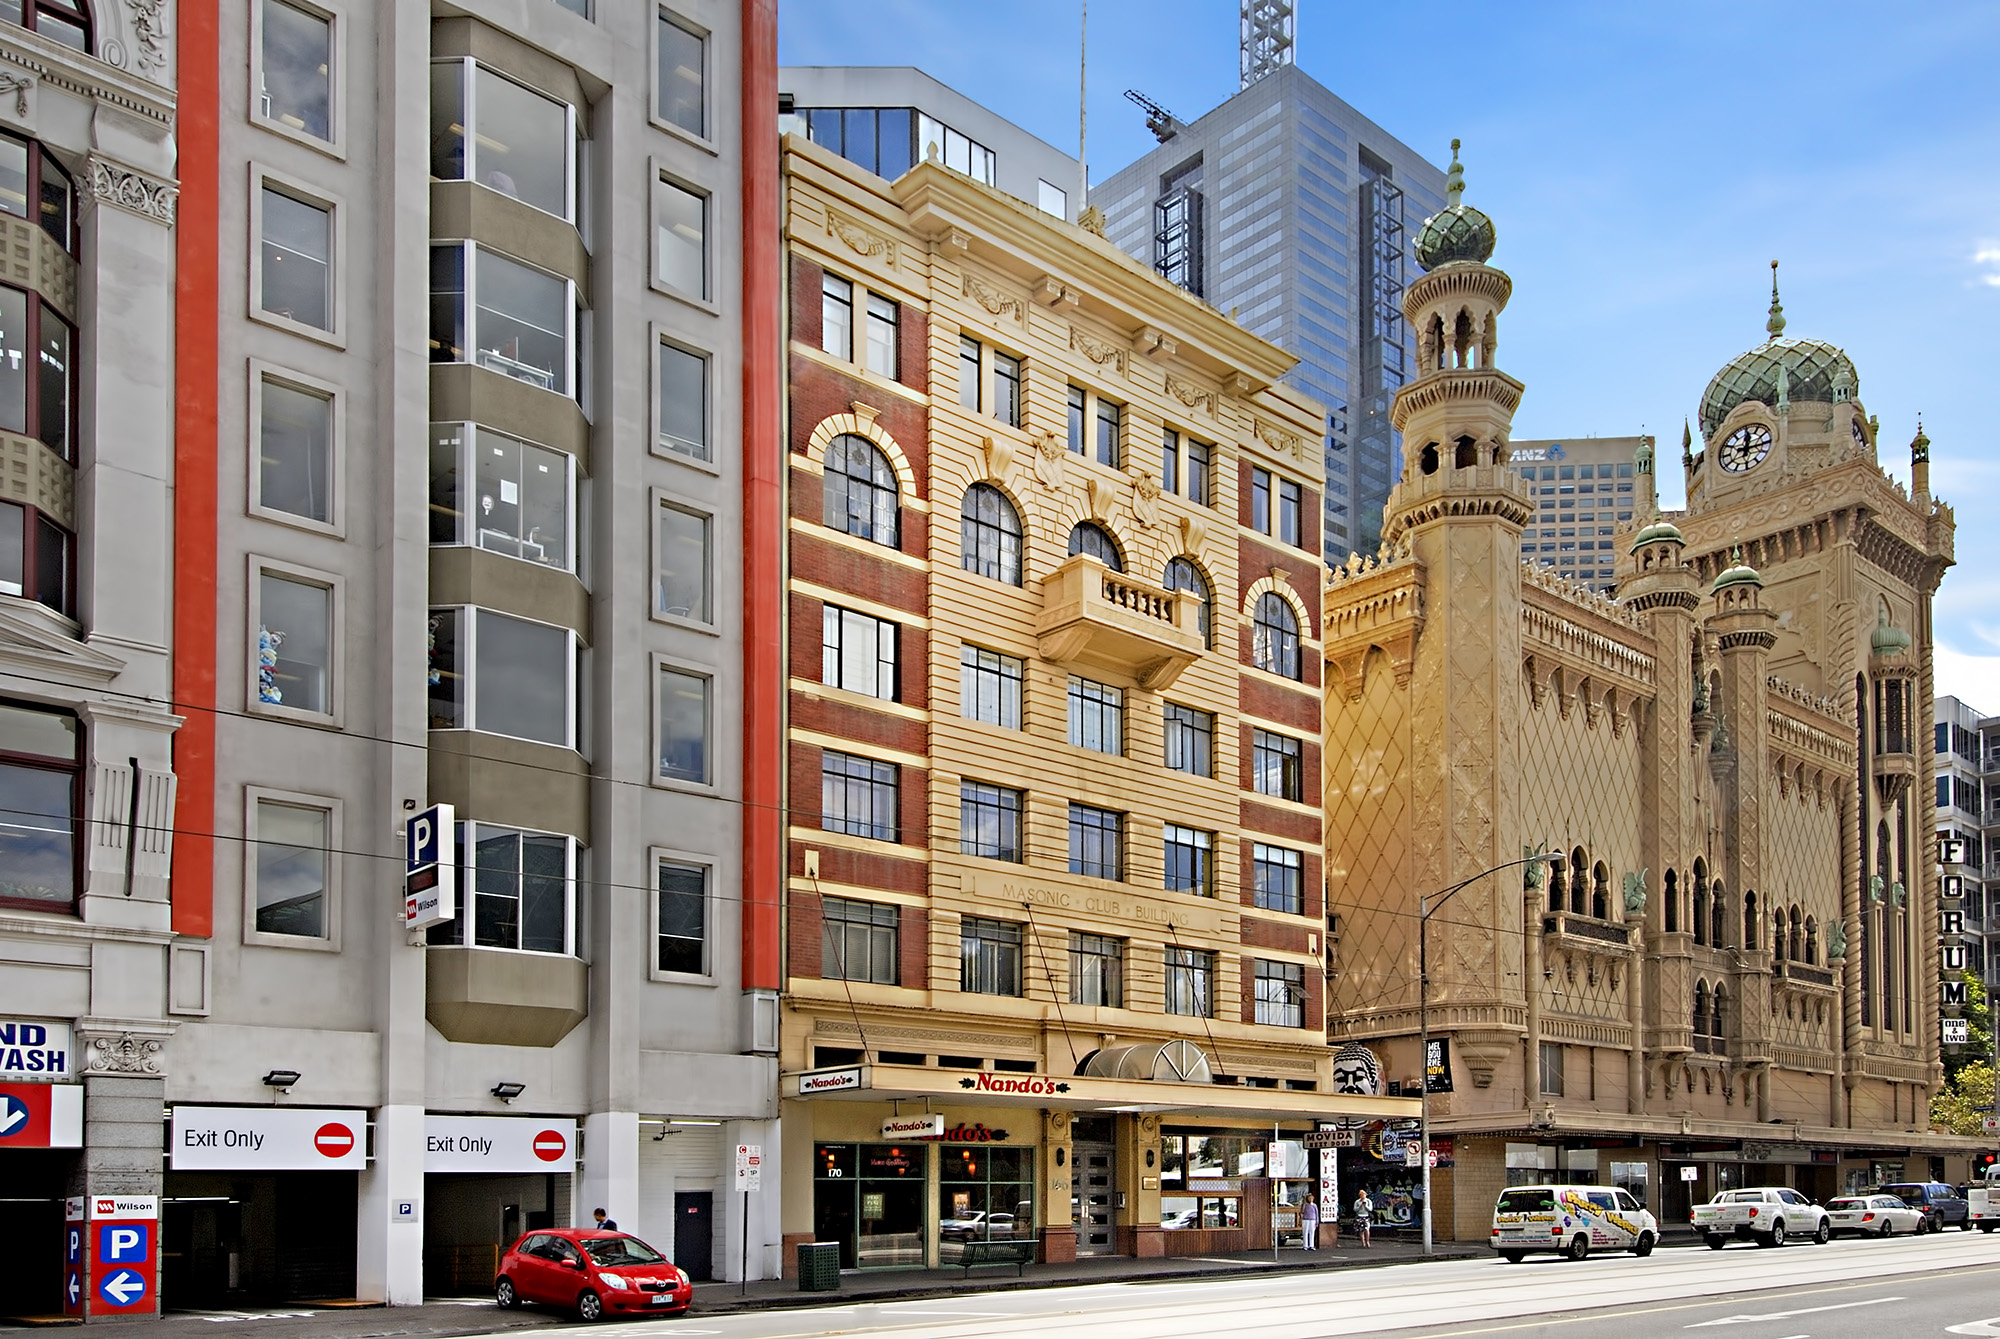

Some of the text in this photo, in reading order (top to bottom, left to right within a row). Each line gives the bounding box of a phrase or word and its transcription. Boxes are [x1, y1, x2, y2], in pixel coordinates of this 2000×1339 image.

[1509, 448, 1546, 462] ANZ
[414, 817, 431, 865] P
[417, 898, 438, 912] Wilson
[1003, 884, 1189, 926] MASONIC CLUB BUILDING
[1942, 839, 1966, 1005] FORUM
[0, 1023, 46, 1046] ND
[1945, 1034, 1965, 1042] two
[1427, 1042, 1440, 1050] MEL
[1427, 1066, 1445, 1075] NOW
[811, 1076, 847, 1088] Nando's
[975, 1073, 1055, 1095] Nando's
[891, 1121, 926, 1132] Nando's
[184, 1130, 264, 1150] Exit Only
[1307, 1131, 1353, 1142] MOVIDA
[427, 1136, 492, 1155] Exit Only
[828, 1168, 842, 1178] 170
[71, 1231, 79, 1260] P
[111, 1229, 139, 1259] P
